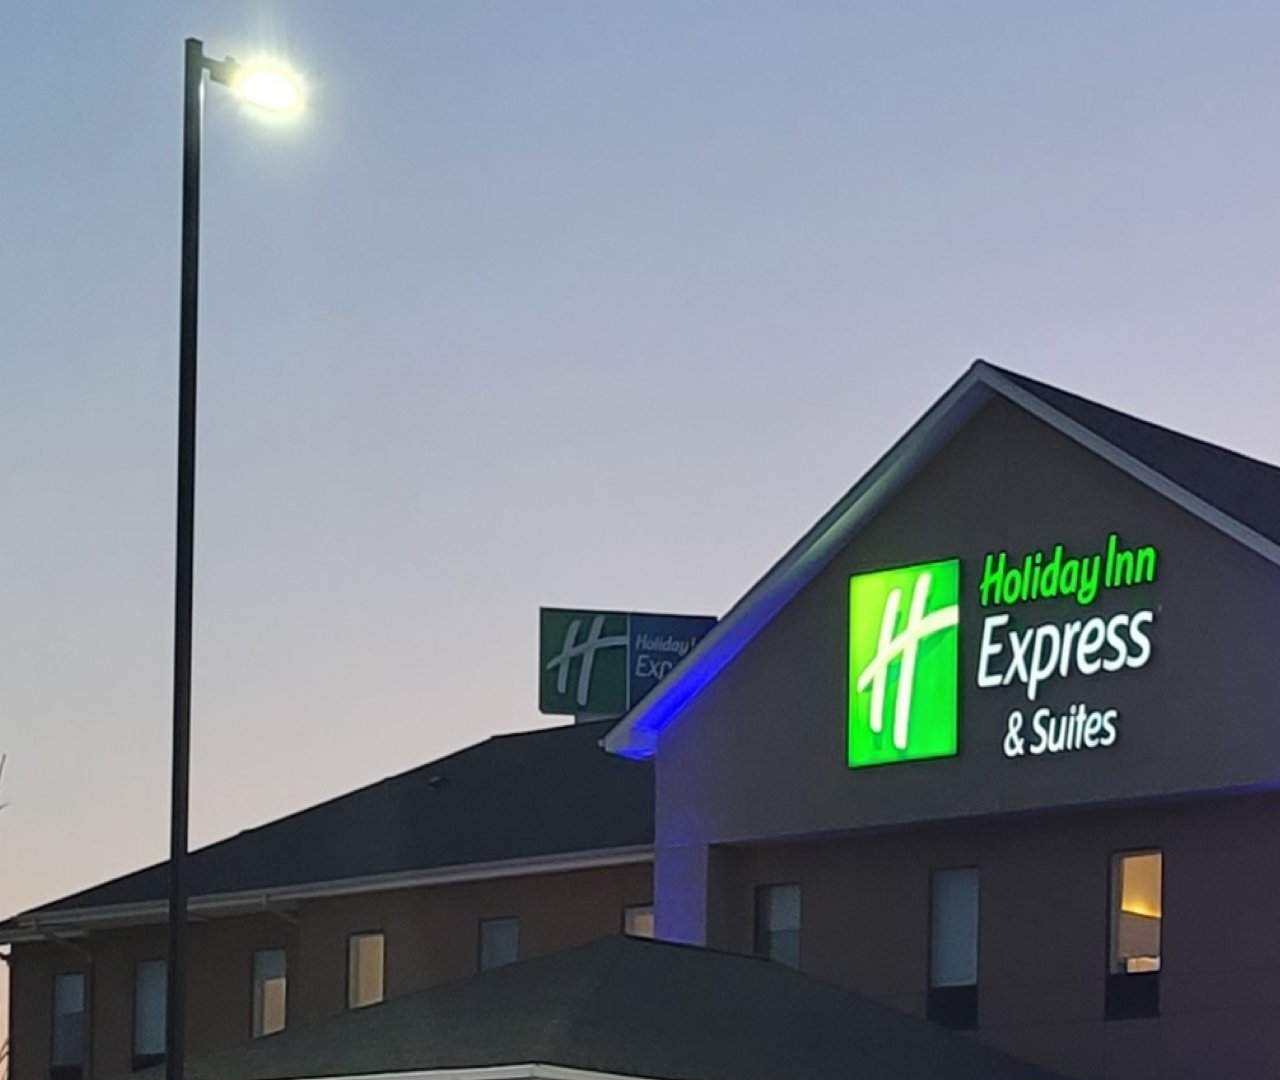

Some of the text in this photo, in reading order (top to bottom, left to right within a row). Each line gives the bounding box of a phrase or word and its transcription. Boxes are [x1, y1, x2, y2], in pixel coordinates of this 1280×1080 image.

[979, 534, 1156, 606] Holiday Inn
[635, 633, 690, 656] Holiday
[977, 610, 1154, 701] Express
[1003, 703, 1118, 757] & Suites
